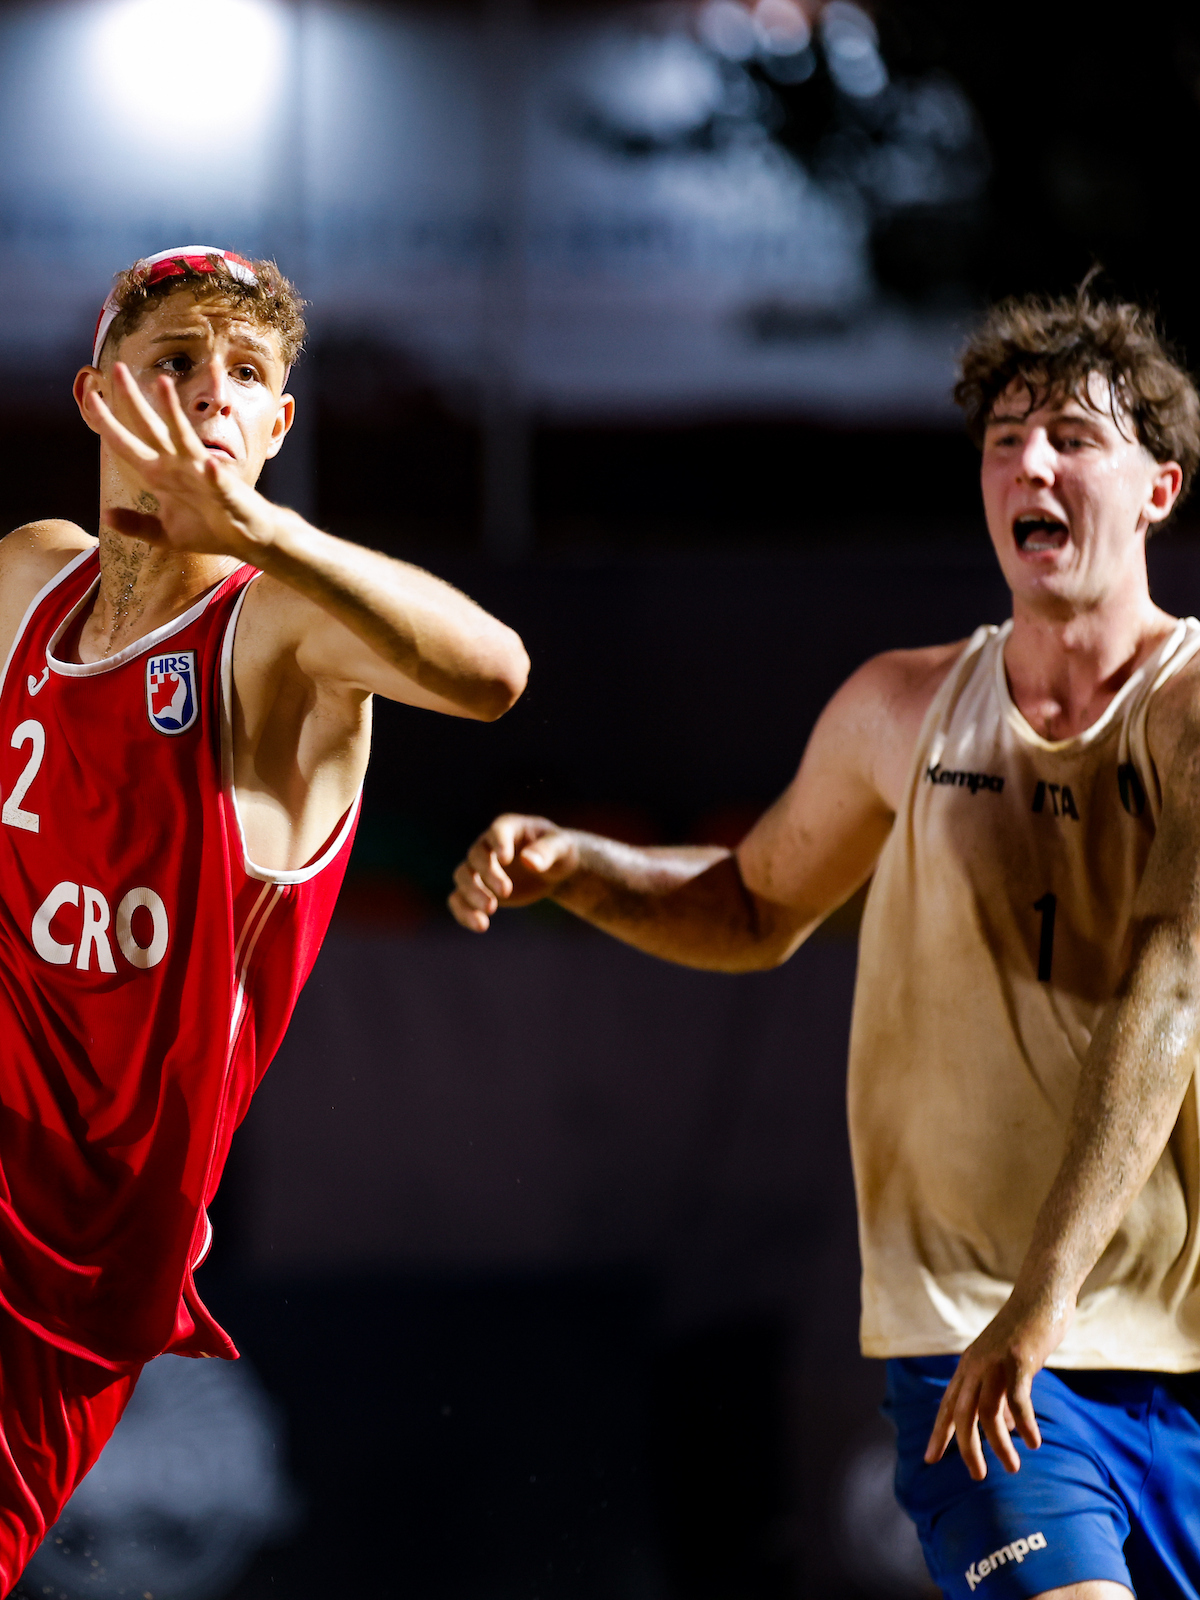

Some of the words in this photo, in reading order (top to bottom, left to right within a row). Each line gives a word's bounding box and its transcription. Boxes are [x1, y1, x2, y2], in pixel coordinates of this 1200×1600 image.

[150, 655, 190, 674] HRS
[1, 719, 45, 833] 2
[926, 763, 1004, 795] Kempa
[31, 881, 169, 973] CRO
[1034, 892, 1056, 982] 1
[965, 1531, 1048, 1592] Kempa
